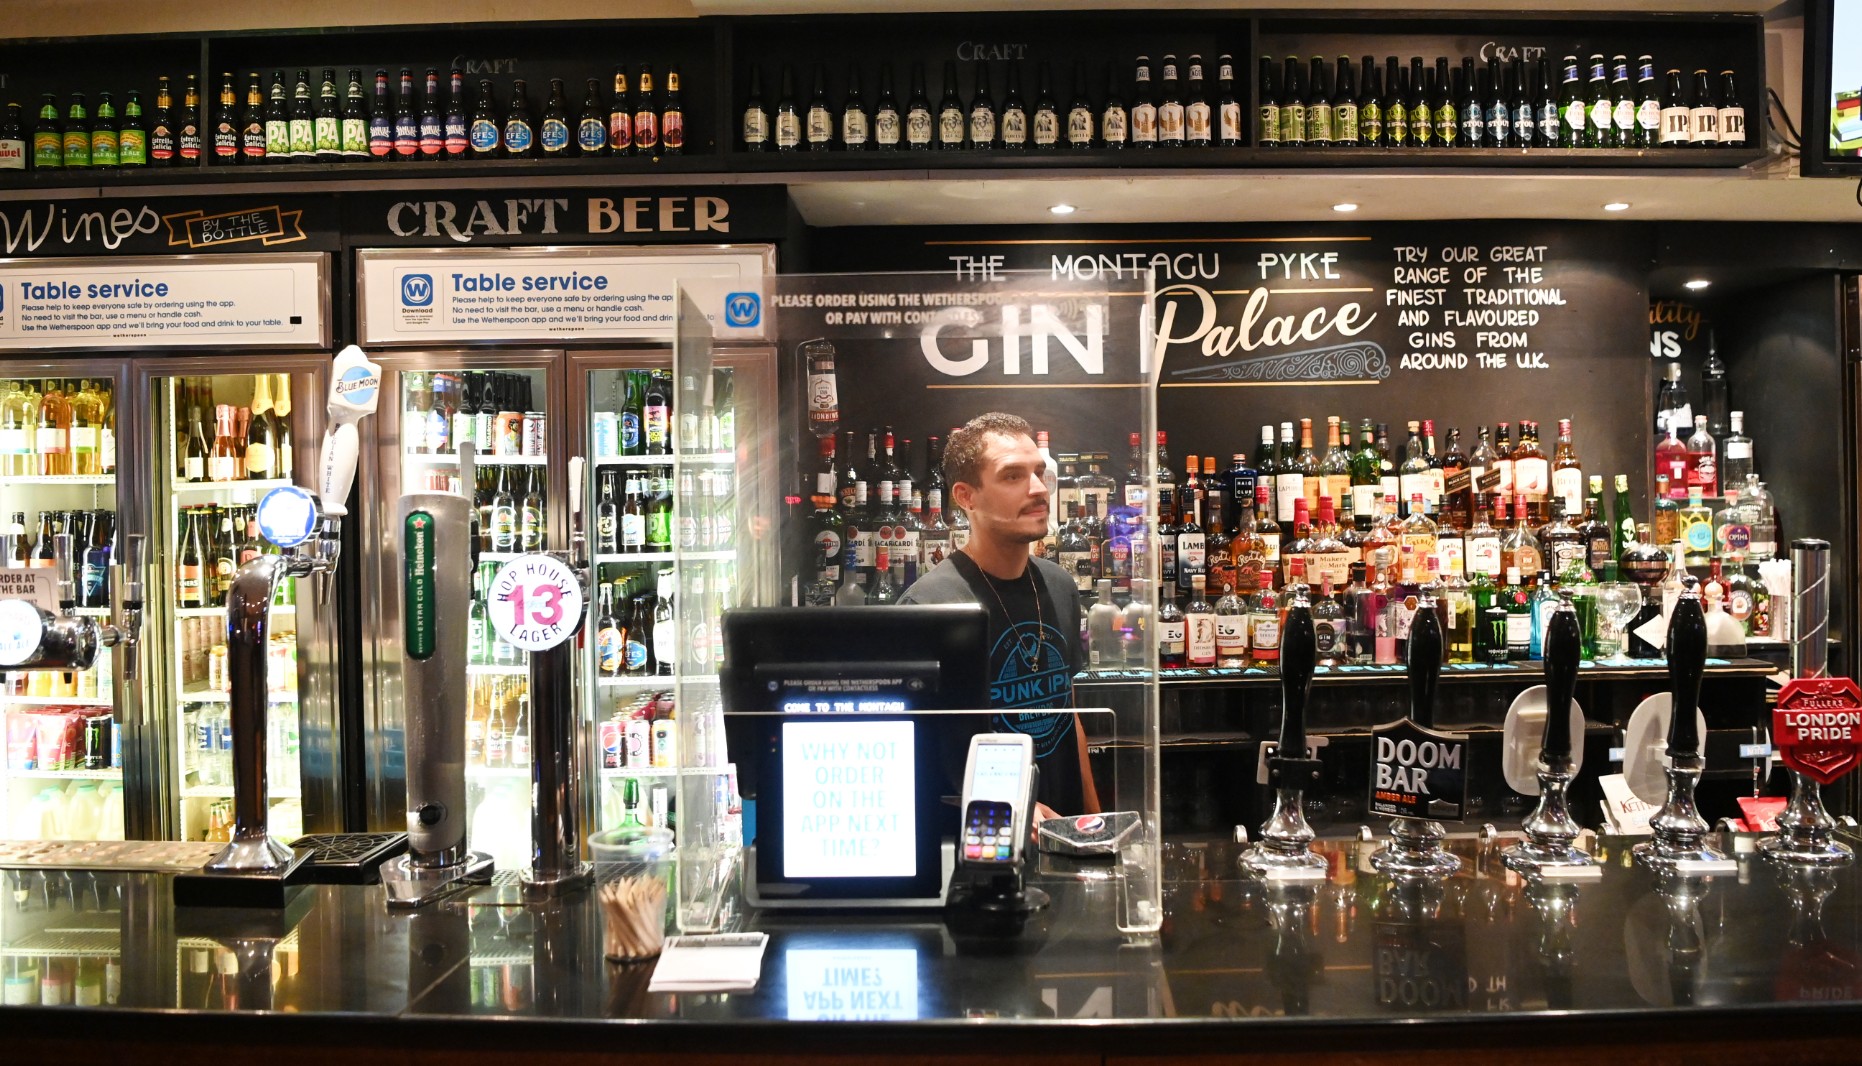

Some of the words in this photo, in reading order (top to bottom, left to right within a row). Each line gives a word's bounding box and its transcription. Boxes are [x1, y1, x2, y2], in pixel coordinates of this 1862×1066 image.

[956, 41, 1028, 61] CRAFT
[1480, 42, 1546, 63] CRAFT
[452, 55, 517, 74] CRAFT
[202, 219, 219, 231] BY
[229, 212, 263, 226] THE
[386, 198, 568, 242] CRAFT
[588, 196, 730, 233] BEER
[0, 203, 160, 254] Wines
[202, 222, 269, 243] BOTTLE
[1393, 246, 1427, 263] TRY
[1442, 247, 1479, 263] OUR
[1490, 246, 1548, 263] GREAT
[949, 255, 1006, 281] THE
[1051, 252, 1220, 281] MONTAGU
[1258, 252, 1340, 280] PYKE
[1394, 267, 1450, 284] RANGE
[1464, 267, 1488, 284] OF
[1503, 267, 1543, 284] THE
[20, 281, 82, 300] Table
[87, 278, 168, 299] service
[451, 273, 516, 292] Table
[522, 271, 608, 292] service
[478, 296, 495, 304] help
[581, 295, 592, 303] by
[593, 294, 625, 303] ordering
[626, 294, 646, 303] using
[771, 295, 813, 308] PLEASE
[815, 294, 856, 307] ORDER
[858, 293, 896, 306] USING
[898, 293, 920, 306] THE
[1386, 289, 1447, 306] FINEST
[1463, 288, 1566, 305] TRADITIONAL
[45, 304, 62, 312] help
[154, 302, 184, 310] ordering
[524, 306, 539, 314] bar,
[623, 304, 646, 312] cash.
[583, 315, 604, 324] bring
[825, 312, 843, 325] OR
[846, 312, 867, 325] PAY
[867, 311, 901, 325] WITH
[1398, 310, 1429, 327] AND
[1444, 310, 1539, 326] FLAVOURED
[920, 304, 1104, 377] GIN
[1152, 284, 1377, 387] Palace
[1409, 332, 1456, 348] GINS
[1476, 332, 1528, 348] FROM
[1400, 353, 1468, 370] AROUND
[1476, 353, 1507, 369] THE
[1516, 352, 1550, 369] U.K.
[336, 382, 358, 393] BLUE
[414, 531, 425, 576] Heineken
[0, 574, 23, 584] RDER
[24, 574, 36, 583] AT
[497, 570, 517, 602] HOP
[526, 564, 572, 599] HOUSE
[16, 585, 36, 594] BAR
[507, 584, 564, 625] 13
[510, 622, 562, 642] LAGER
[784, 703, 810, 712] COME
[815, 703, 830, 712] TO
[834, 702, 854, 712] THE
[1785, 712, 1860, 727] LONDON
[1797, 727, 1852, 740] PRIDE
[802, 743, 848, 760] WHY
[857, 741, 896, 760] NOT
[1377, 736, 1461, 769] DOOM
[815, 766, 884, 784] ORDER
[1376, 763, 1430, 795] BAR
[813, 790, 842, 808] ON
[851, 790, 886, 808] THE
[1375, 791, 1400, 801] AMBER
[1402, 795, 1417, 804] ALE
[802, 815, 840, 832] APP
[848, 814, 899, 832] NEXT
[822, 838, 880, 857] TIME?
